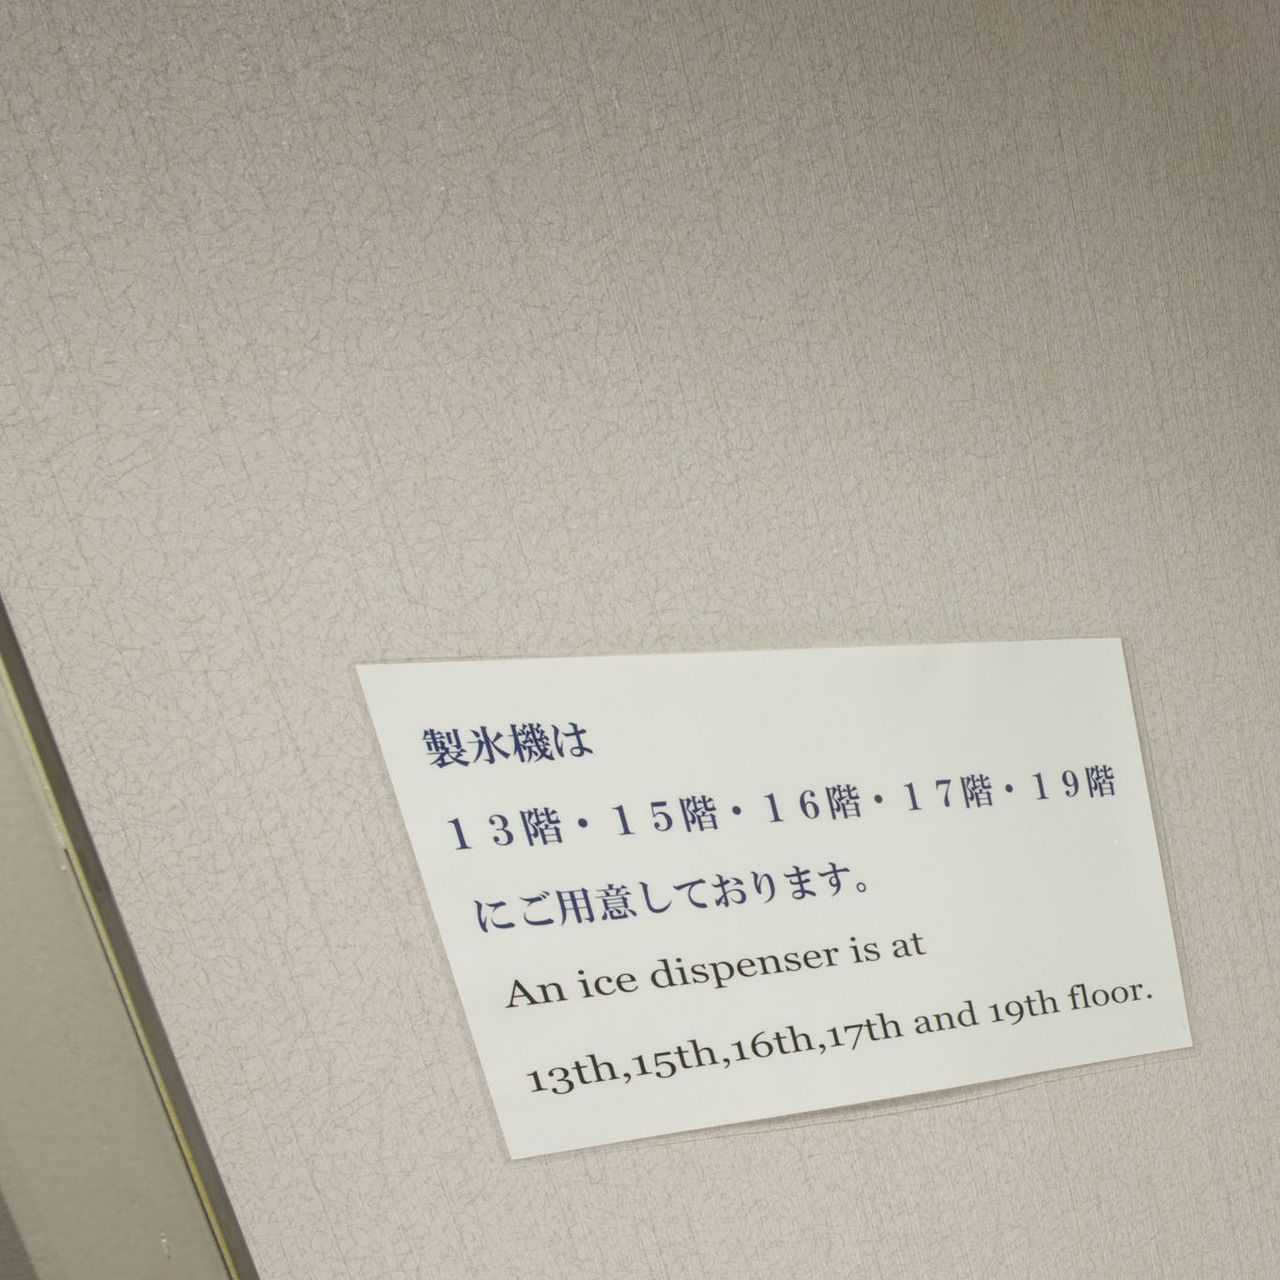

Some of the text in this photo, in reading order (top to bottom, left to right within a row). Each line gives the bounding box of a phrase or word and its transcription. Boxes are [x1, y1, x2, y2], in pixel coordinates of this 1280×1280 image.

[421, 719, 595, 771] 製氷機は
[474, 859, 871, 936] にご用意しております。
[504, 929, 928, 1011] An ice dispenser is at
[525, 979, 1155, 1098] 13th,15th,16th,17th and 19th floor.
